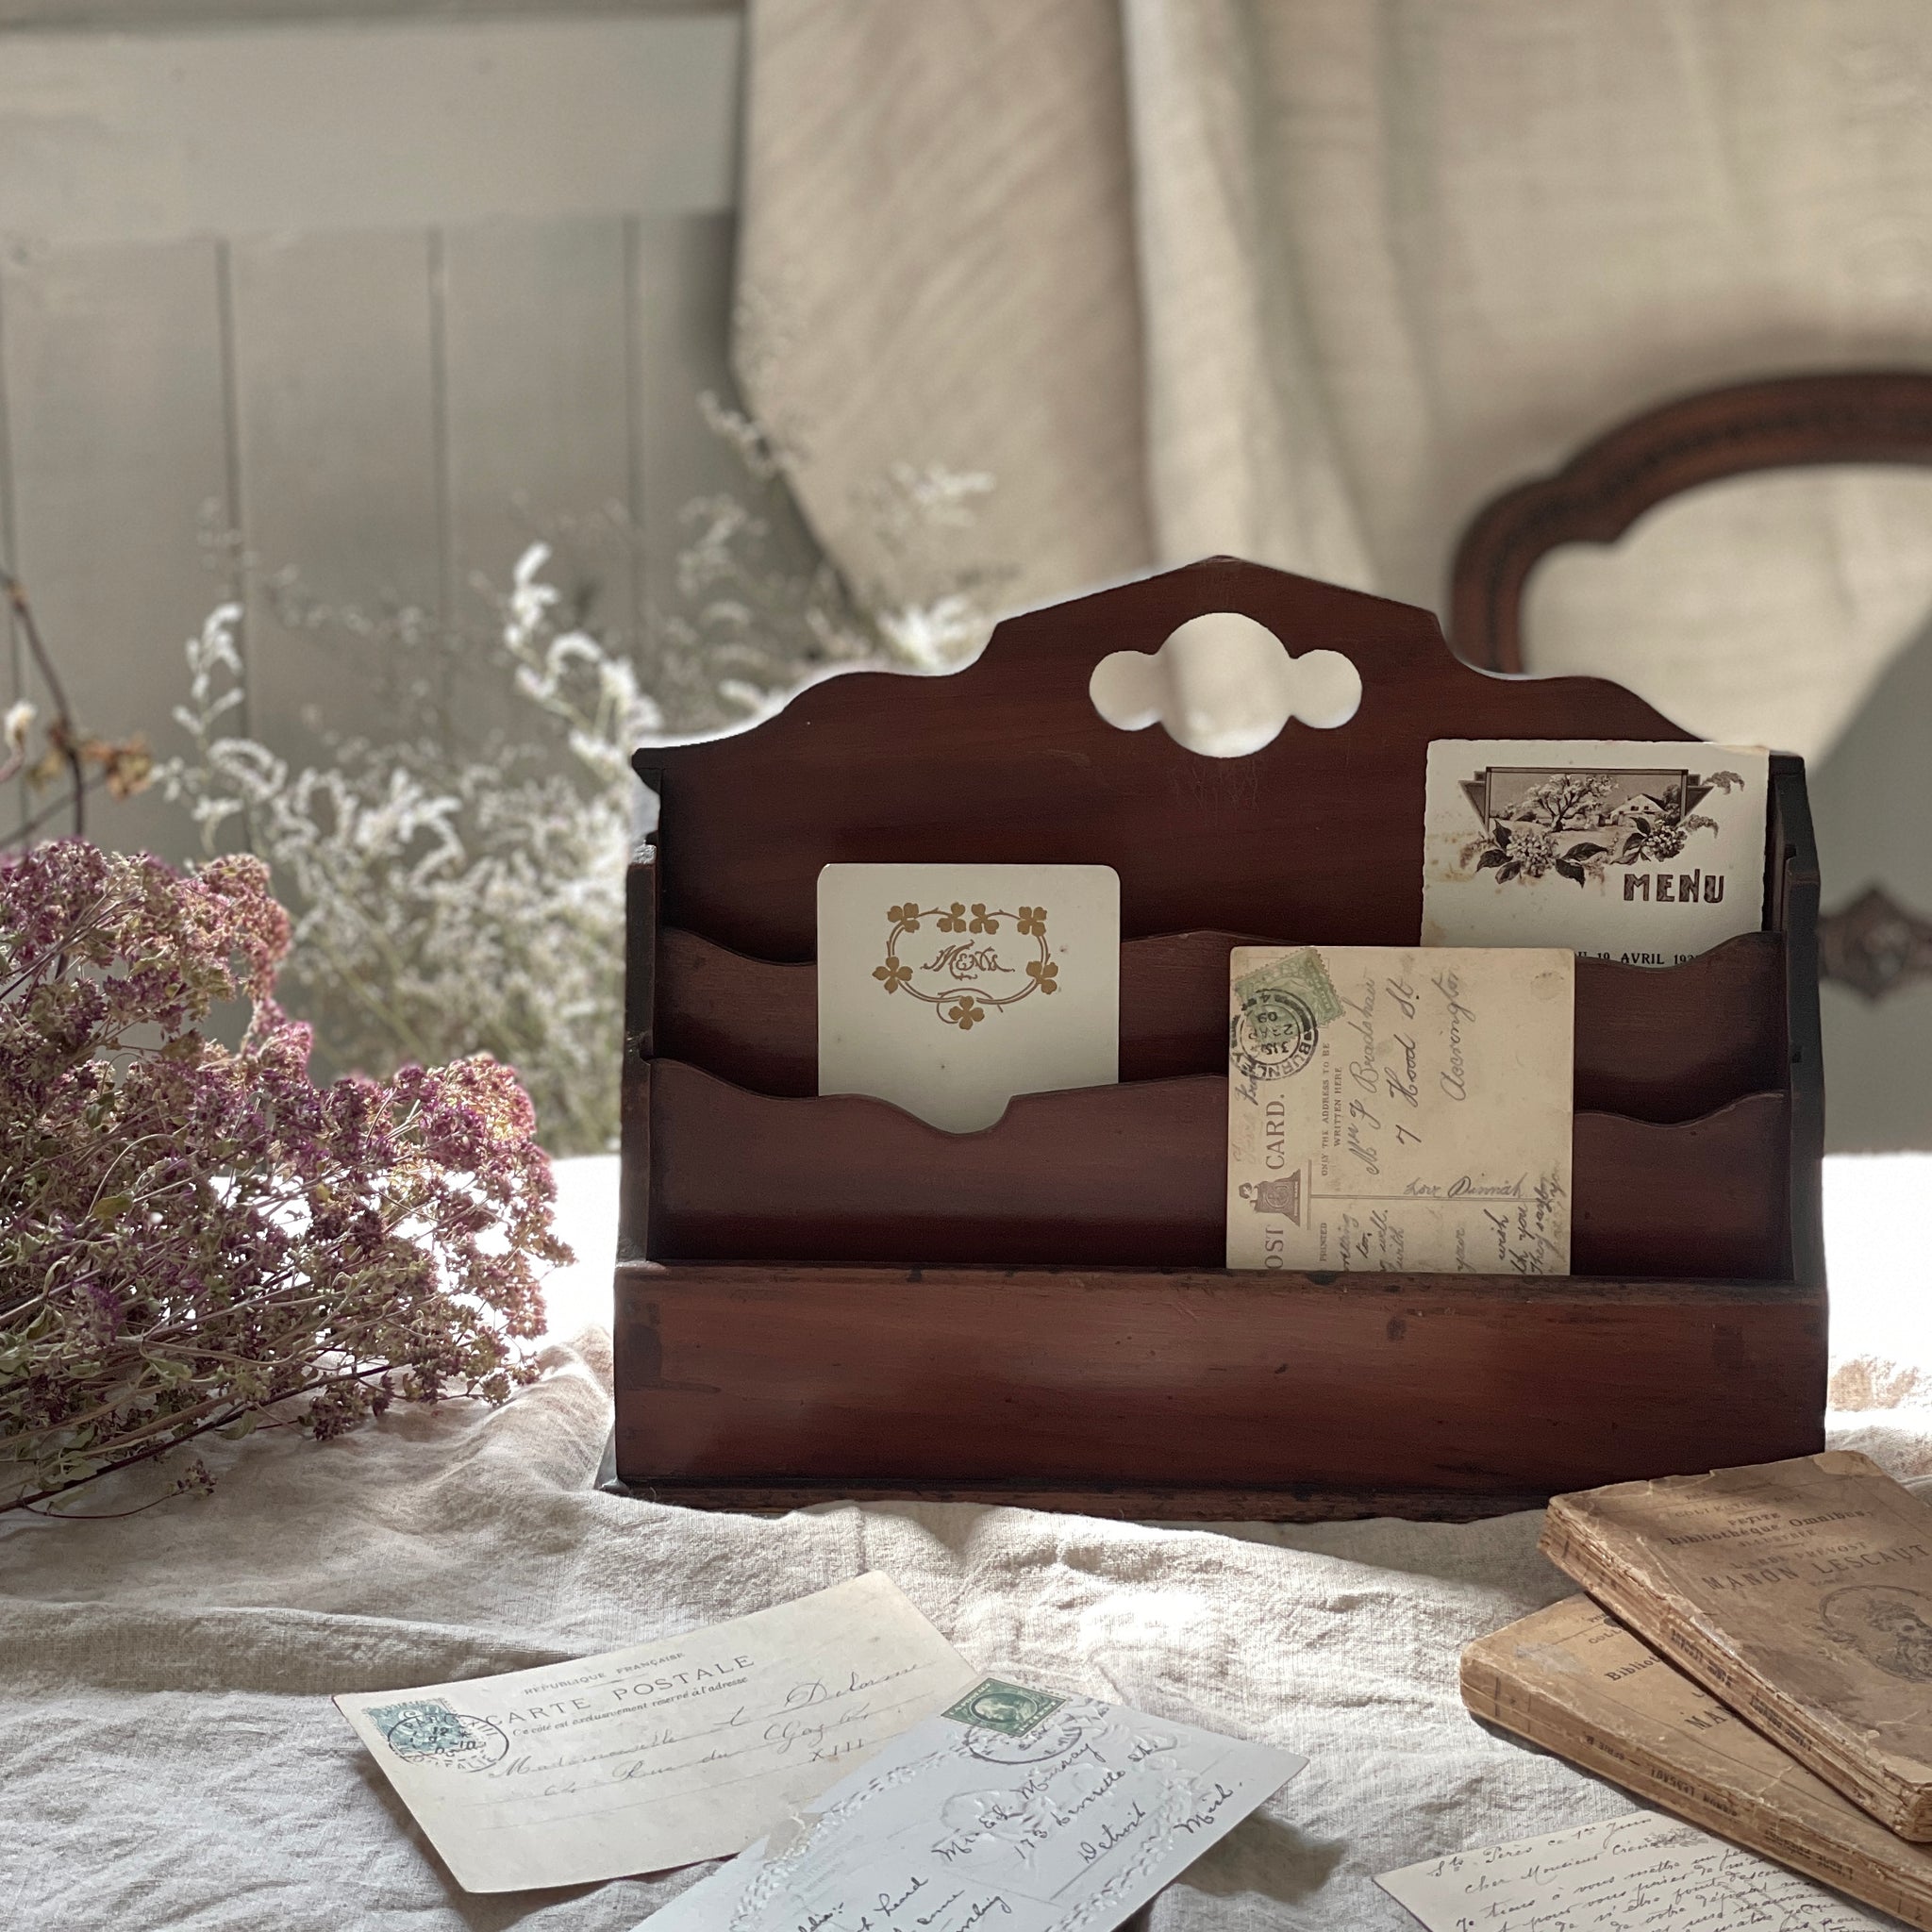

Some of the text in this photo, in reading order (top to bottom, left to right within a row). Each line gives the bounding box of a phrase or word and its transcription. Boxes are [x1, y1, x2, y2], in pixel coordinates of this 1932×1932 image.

[1624, 869, 1724, 903] MENU
[1621, 953, 1665, 965] AVRIL
[1322, 1042, 1330, 1057] BE
[1322, 1060, 1330, 1074] TO
[1334, 1067, 1342, 1146] WRITTEN HERE
[1321, 1130, 1329, 1148] THE
[1321, 1153, 1329, 1176] ONLY
[1264, 1093, 1285, 1269] OST CARD.
[1701, 1542, 1928, 1591] MANON LESCAUT
[1605, 1656, 1661, 1681] Bibliot
[485, 1655, 755, 1726] CARTE POSTALE
[1078, 1801, 1146, 1864] Detroit
